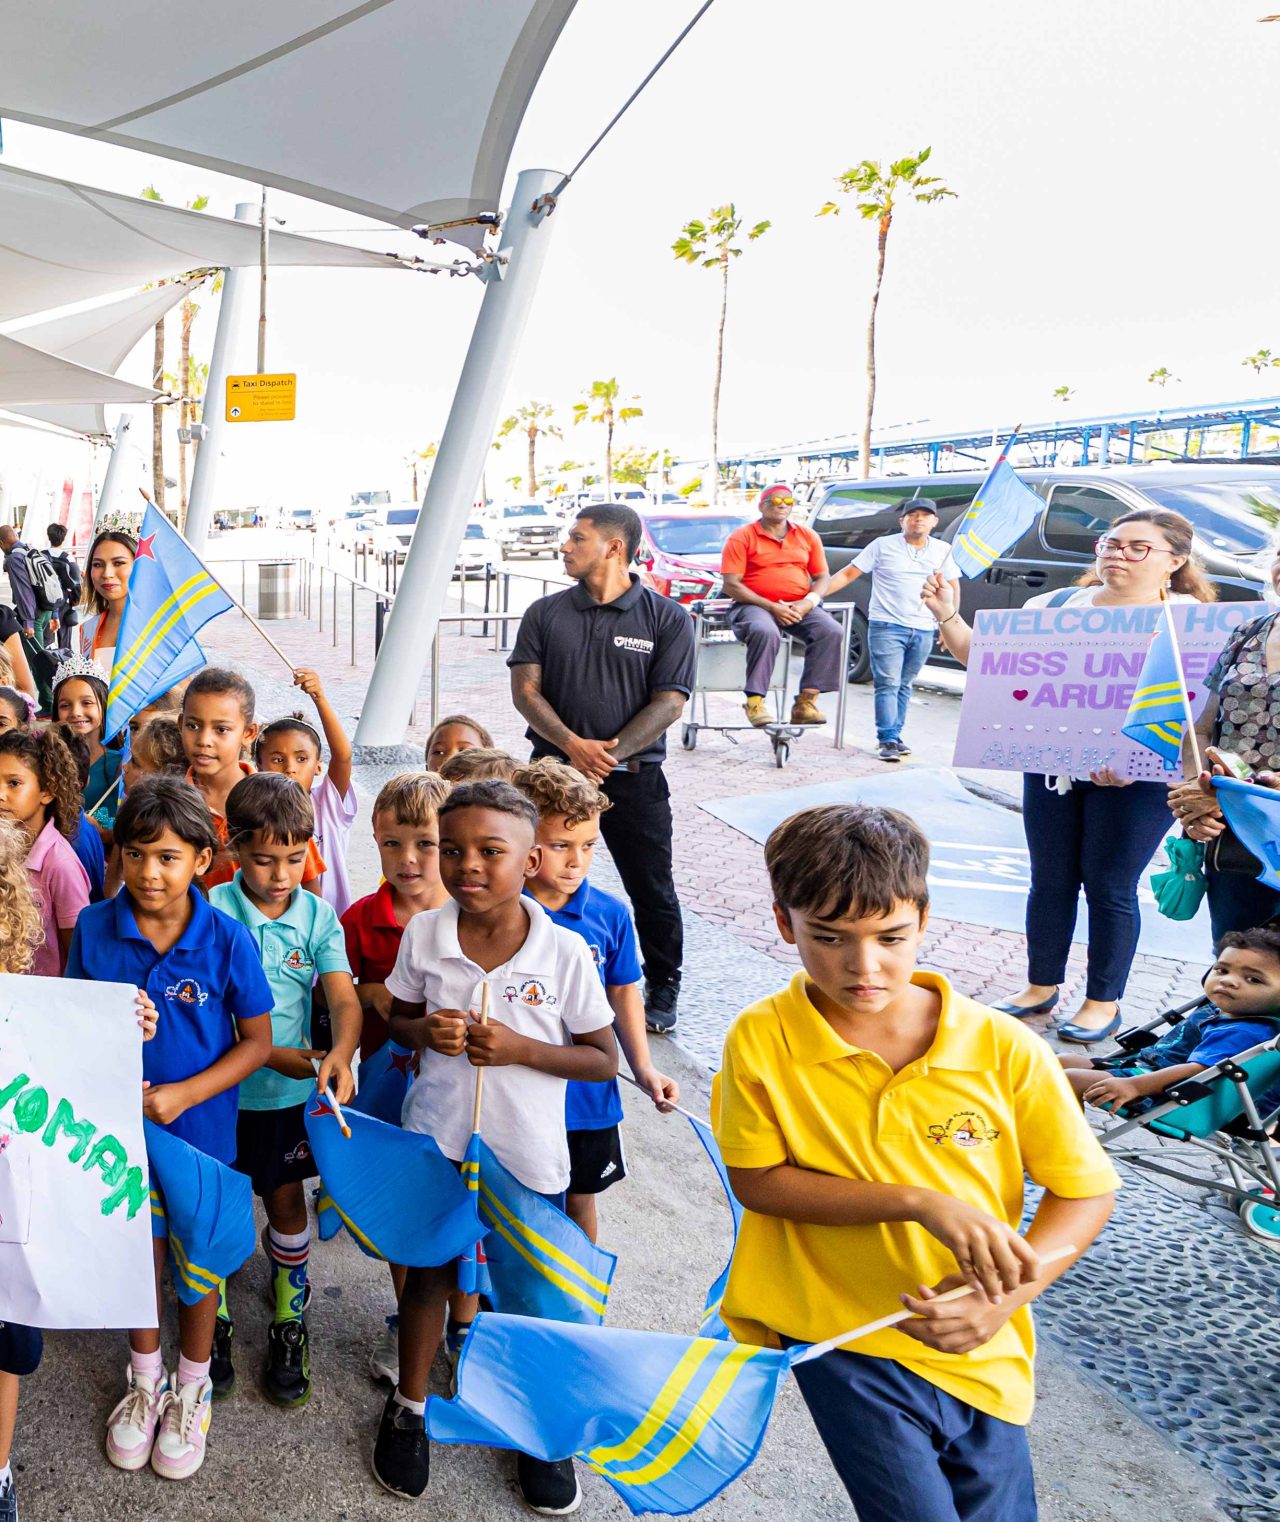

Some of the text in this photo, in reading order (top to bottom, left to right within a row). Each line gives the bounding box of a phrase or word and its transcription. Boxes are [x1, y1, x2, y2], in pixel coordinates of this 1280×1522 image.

[243, 379, 292, 388] Taxi Dispatch
[977, 605, 1269, 635] WELCOME HO
[980, 651, 1068, 677] MISS
[1031, 683, 1138, 710] ARUB
